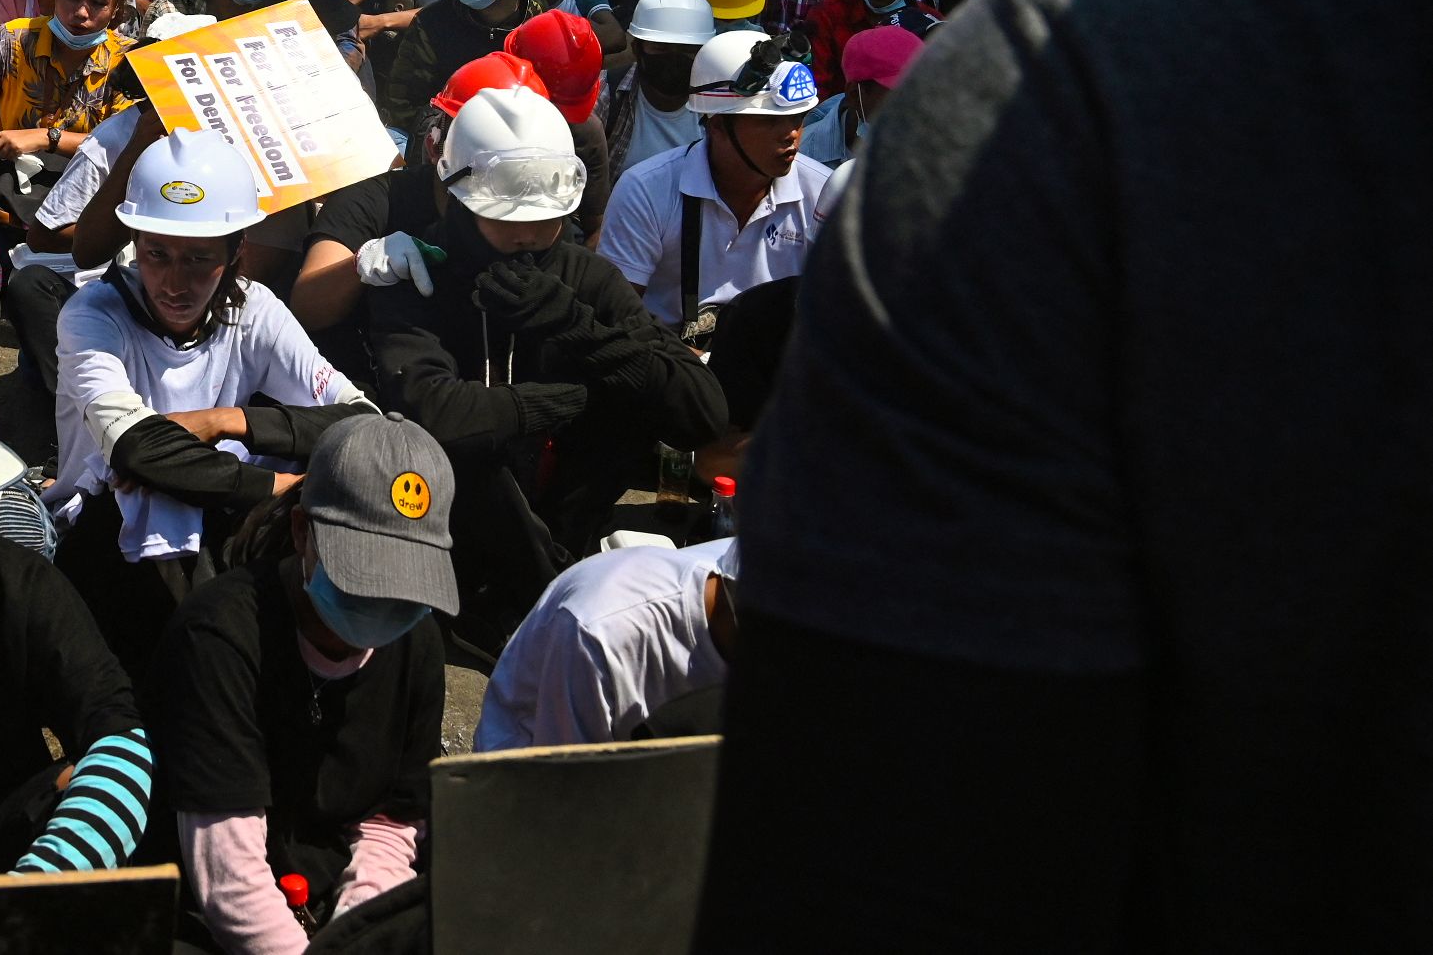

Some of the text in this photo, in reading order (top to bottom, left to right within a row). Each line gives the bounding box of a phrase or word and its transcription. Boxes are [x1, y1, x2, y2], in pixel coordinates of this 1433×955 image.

[175, 57, 203, 85] For
[243, 40, 273, 72] For
[213, 56, 294, 181] For Freedom
[399, 498, 424, 511] drew
